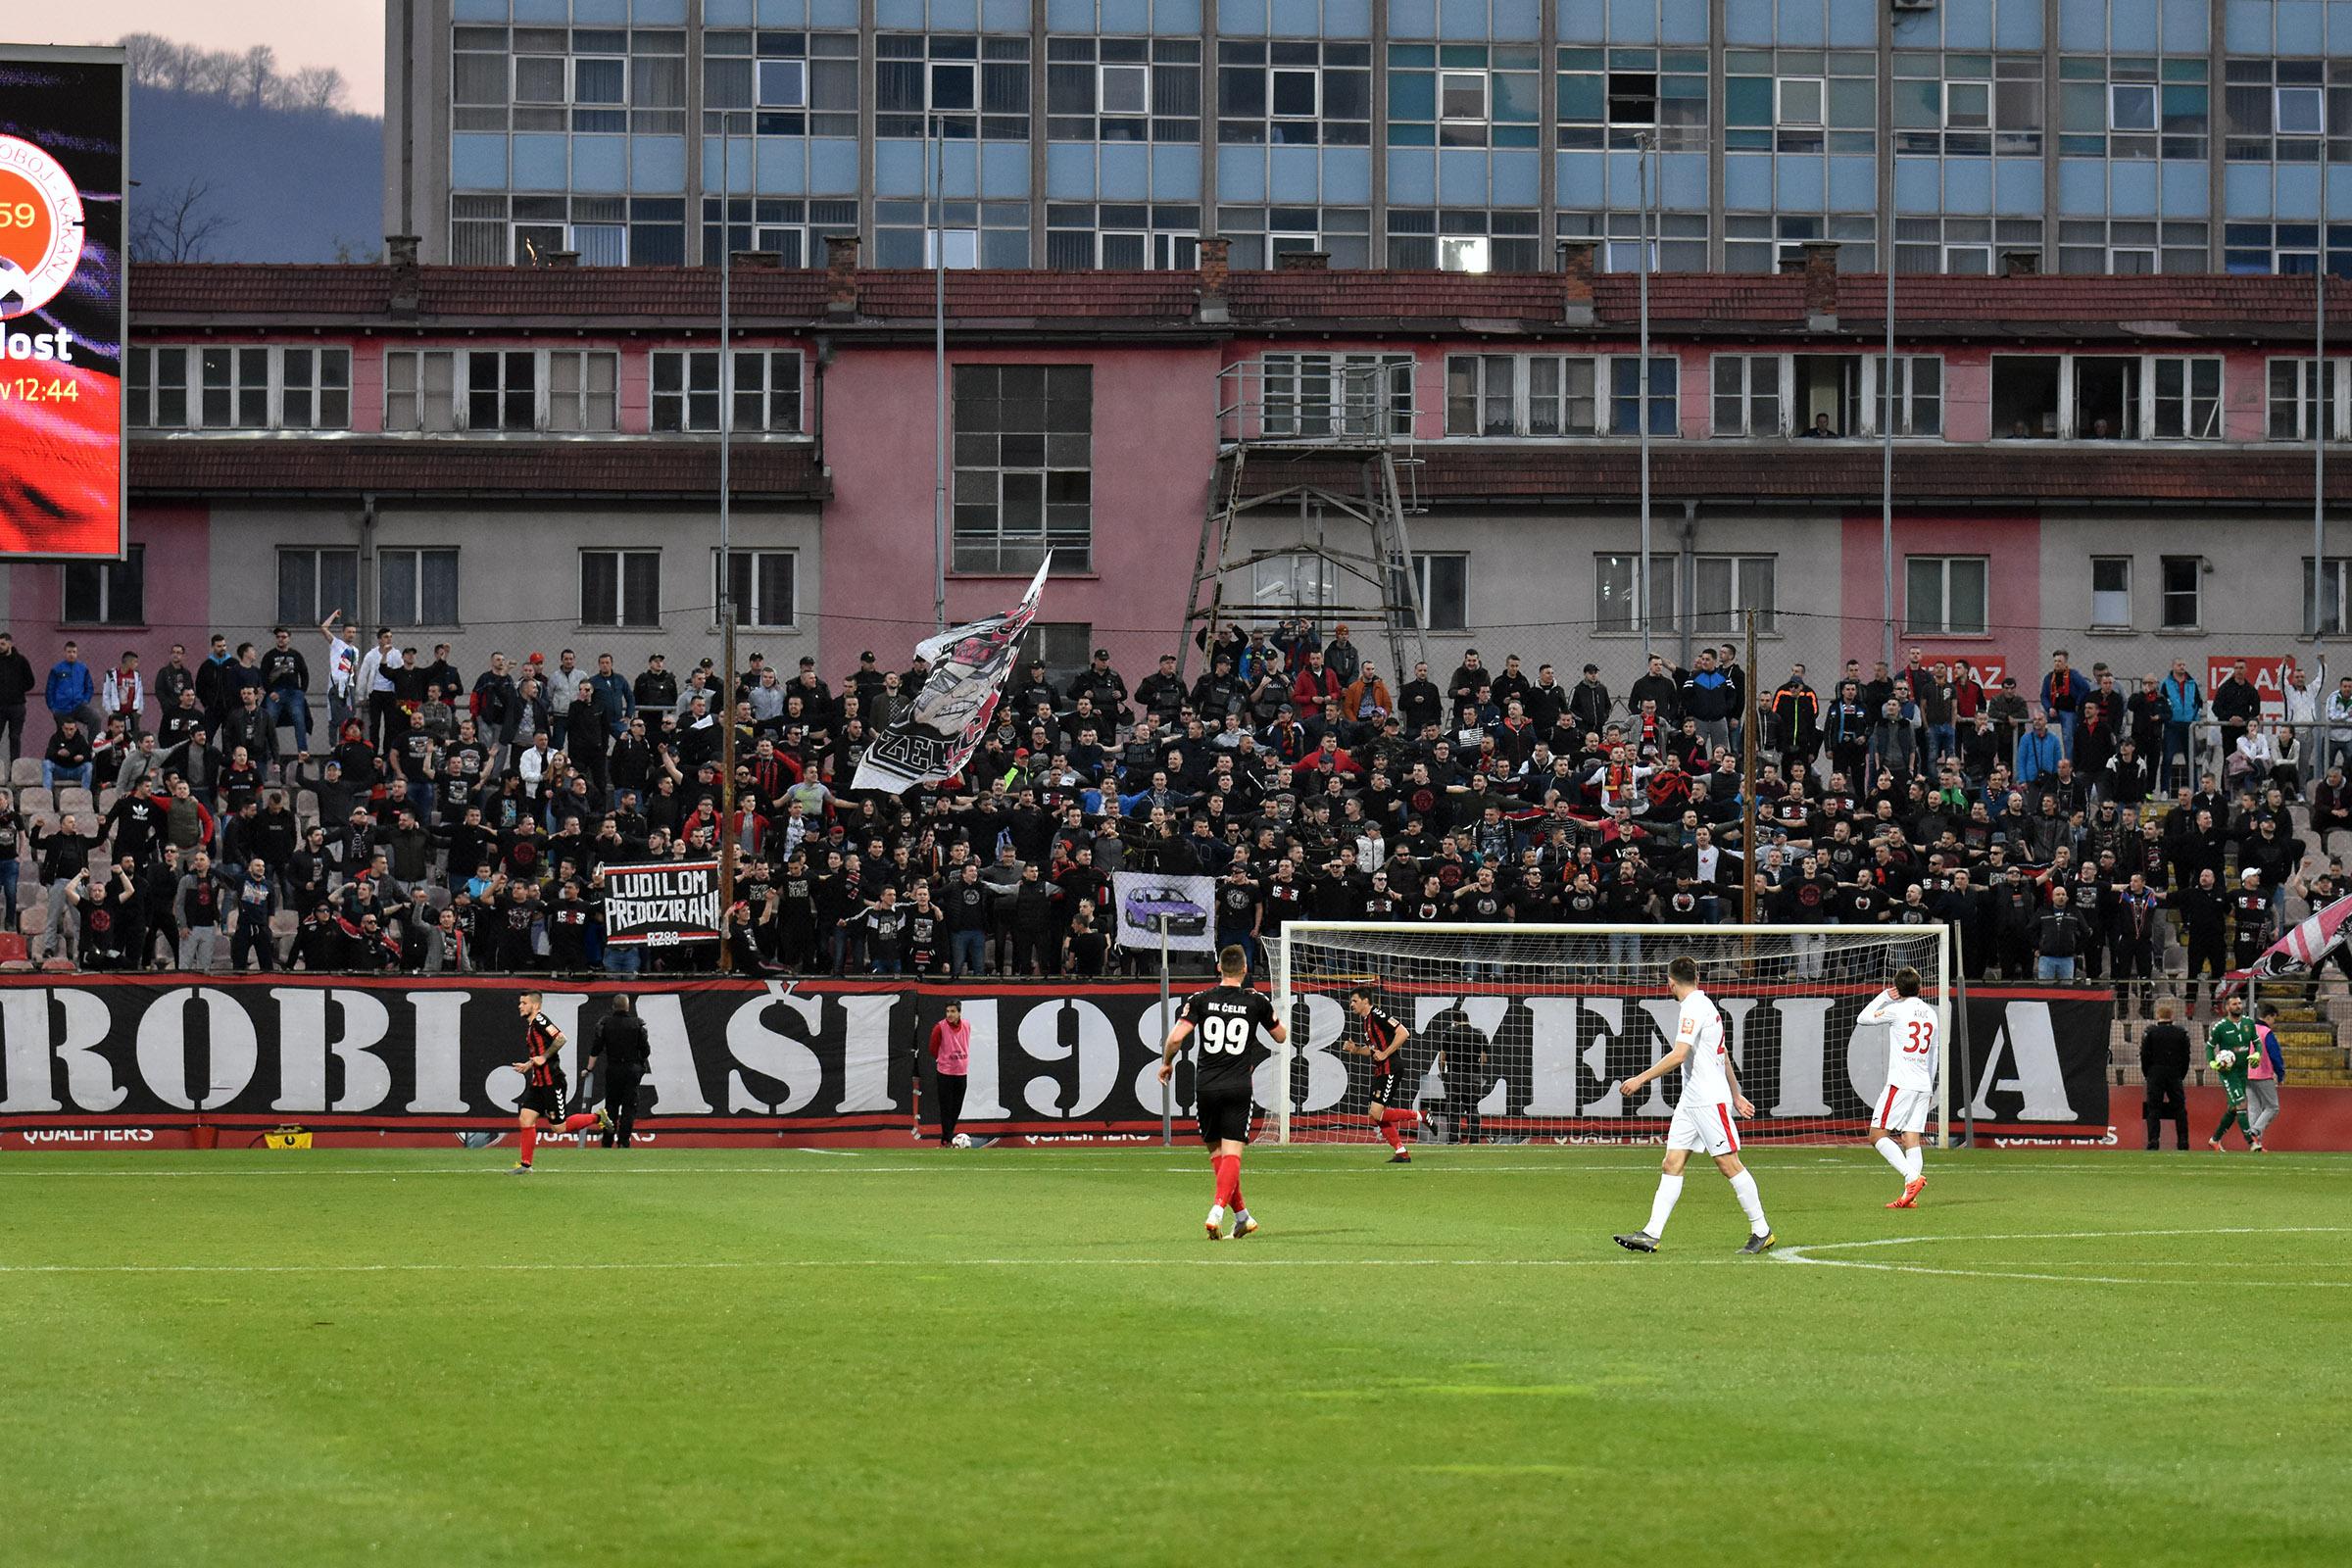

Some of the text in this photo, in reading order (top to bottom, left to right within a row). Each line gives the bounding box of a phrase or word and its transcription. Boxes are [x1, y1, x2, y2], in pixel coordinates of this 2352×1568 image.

[15, 377, 79, 403] 12:44
[612, 870, 708, 899] LUDILOM
[605, 889, 720, 937] PREDOZIRANI
[647, 931, 680, 947] RZ88
[1208, 1002, 1247, 1014] NK ČELIK
[0, 980, 900, 1115] ROBIJAŠI
[1409, 995, 2079, 1121] ZENICA
[1203, 1015, 1250, 1055] 99
[1903, 1021, 1934, 1054] 33
